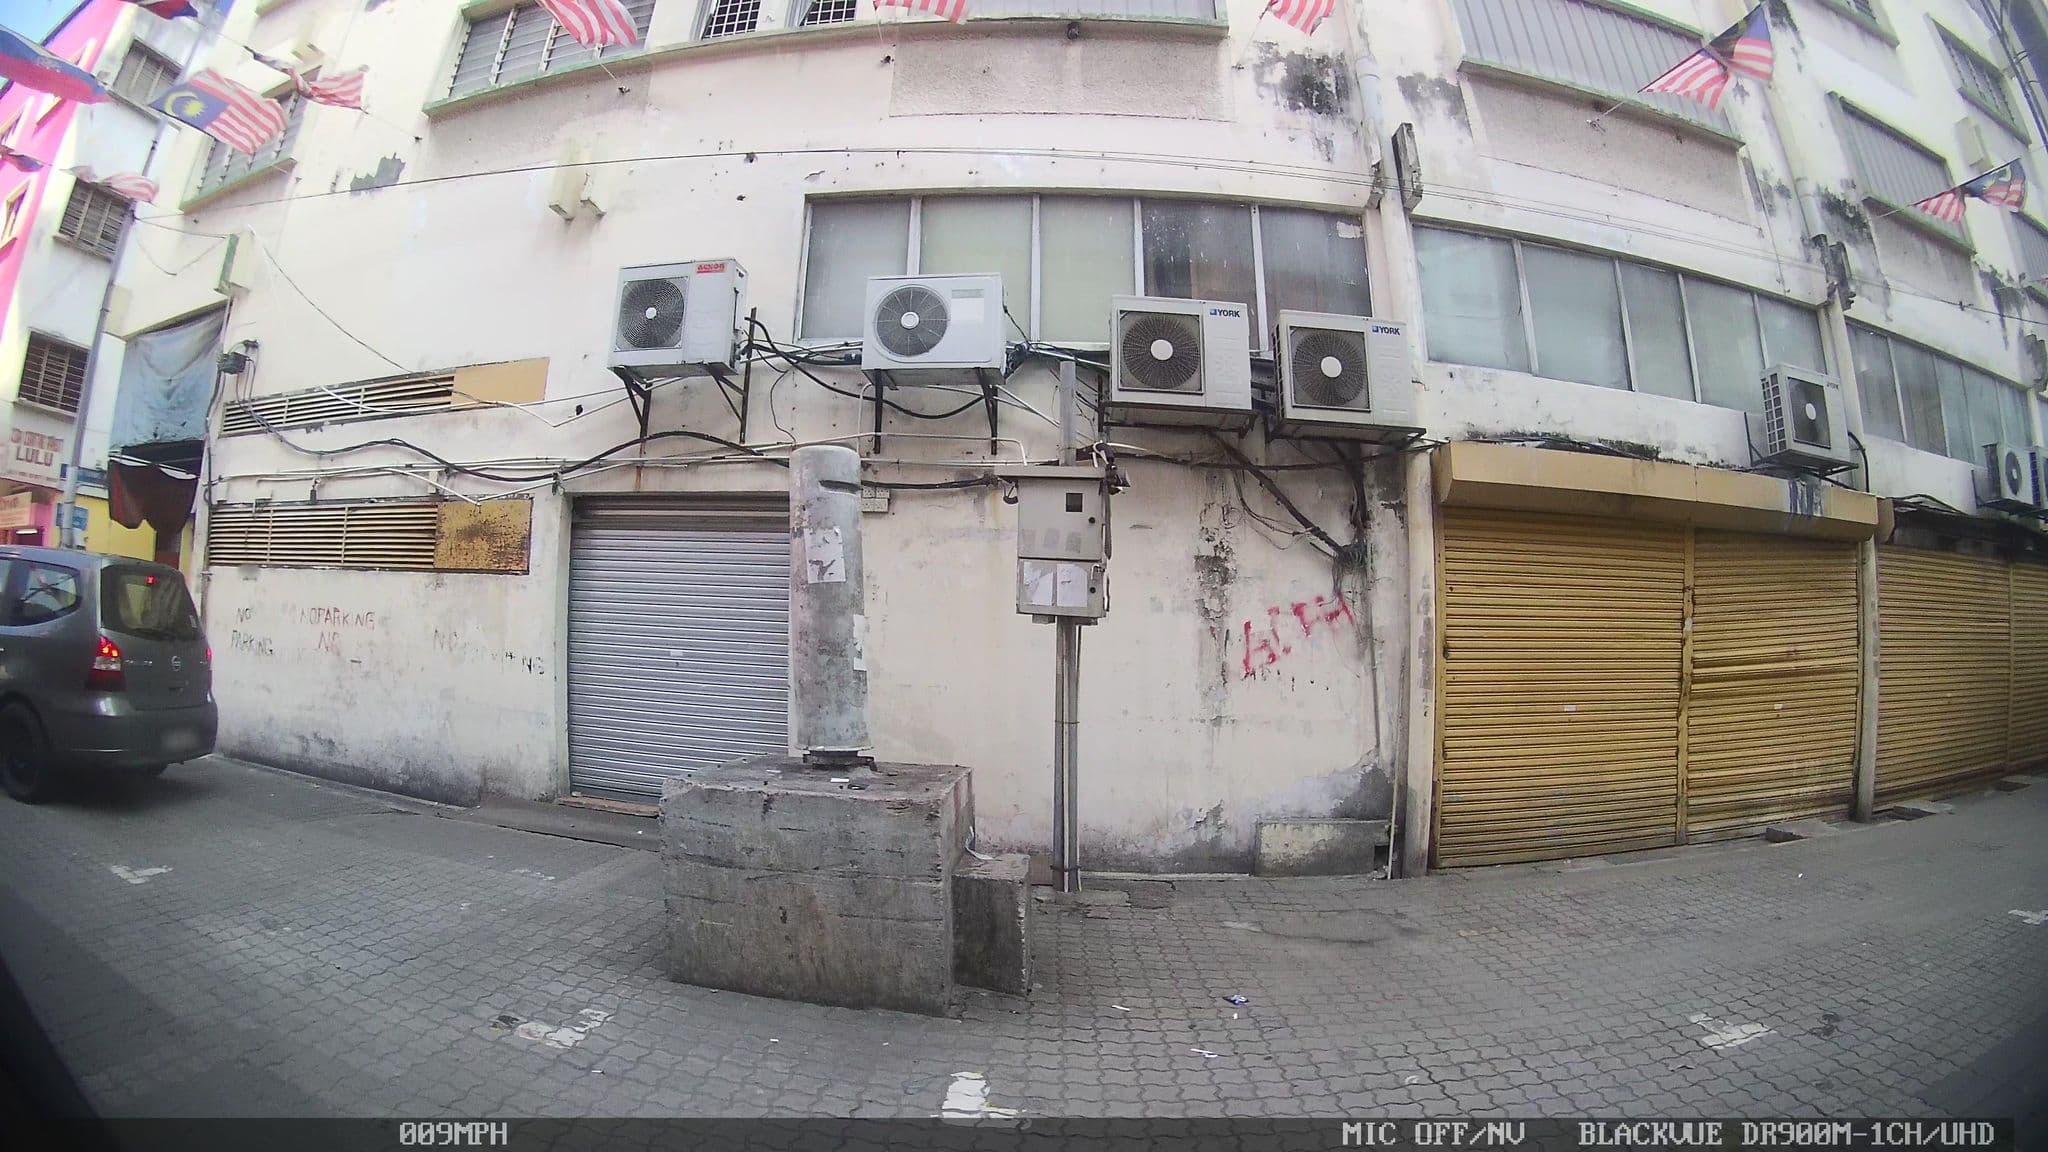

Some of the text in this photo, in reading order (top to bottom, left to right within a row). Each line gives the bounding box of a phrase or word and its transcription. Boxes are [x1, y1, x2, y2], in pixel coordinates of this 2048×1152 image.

[1217, 308, 1240, 318] YORK
[1379, 325, 1401, 336] YORK
[16, 446, 54, 467] LULU
